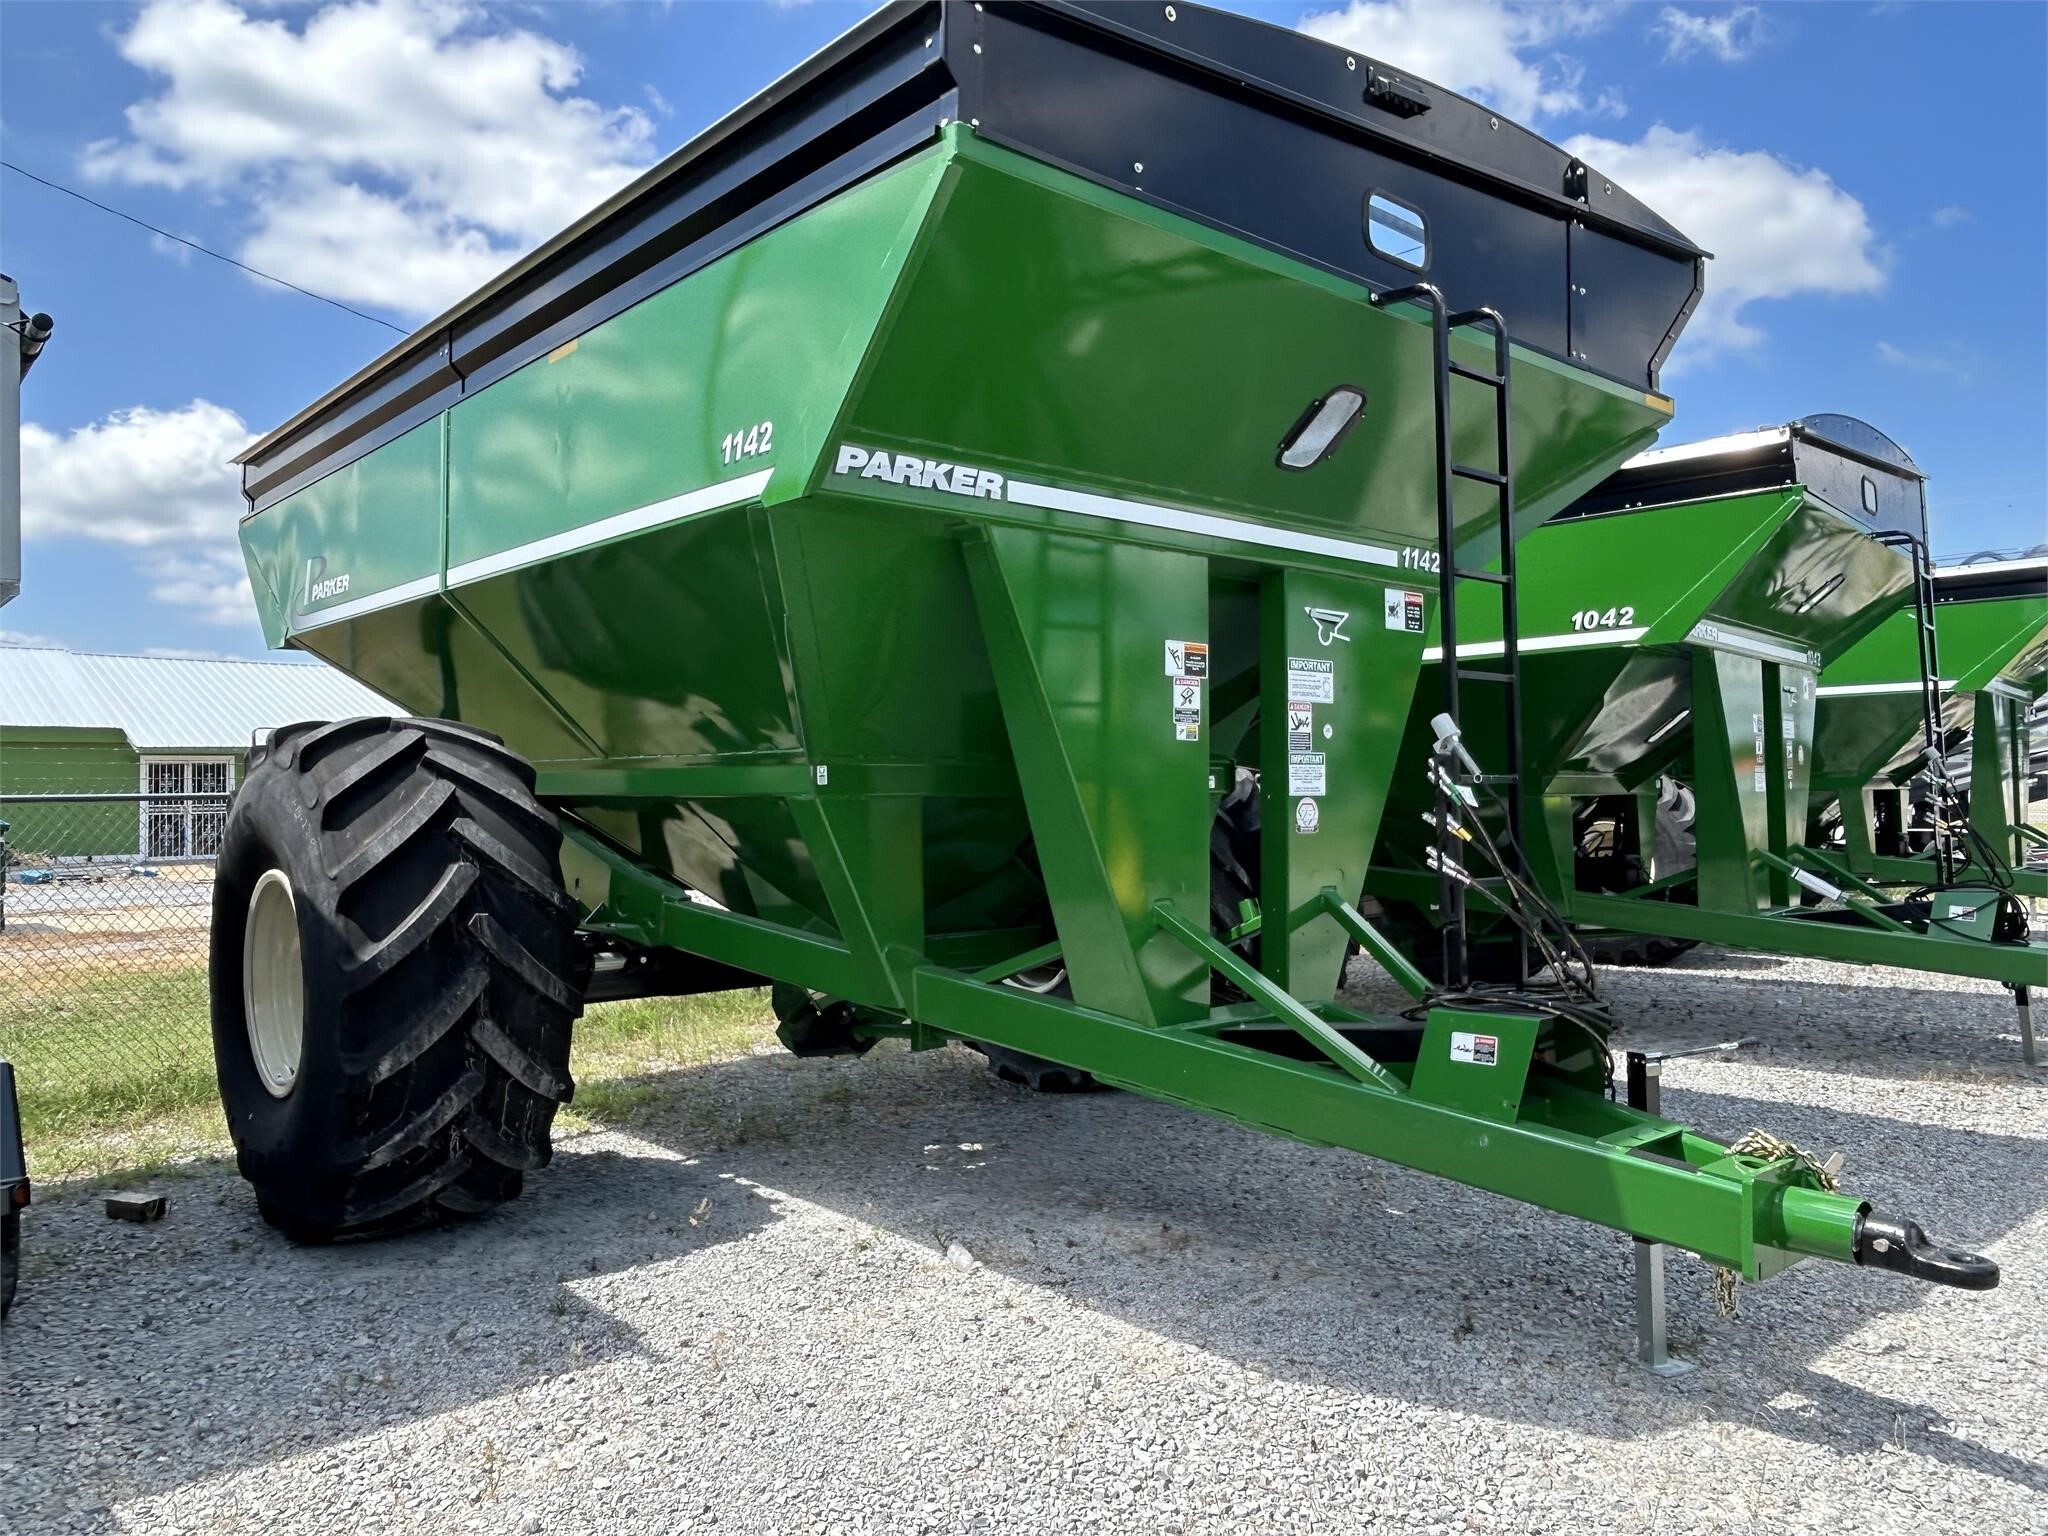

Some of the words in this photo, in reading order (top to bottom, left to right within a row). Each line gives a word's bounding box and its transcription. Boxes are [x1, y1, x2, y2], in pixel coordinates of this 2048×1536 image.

[721, 420, 773, 466] 1142
[834, 444, 1004, 500] PARKER
[1402, 546, 1440, 574] 1142
[311, 573, 350, 602] PARKER
[1571, 606, 1634, 631] 1042
[1290, 660, 1330, 672] IMPORTANT
[1290, 754, 1323, 764] IMPORTANT
